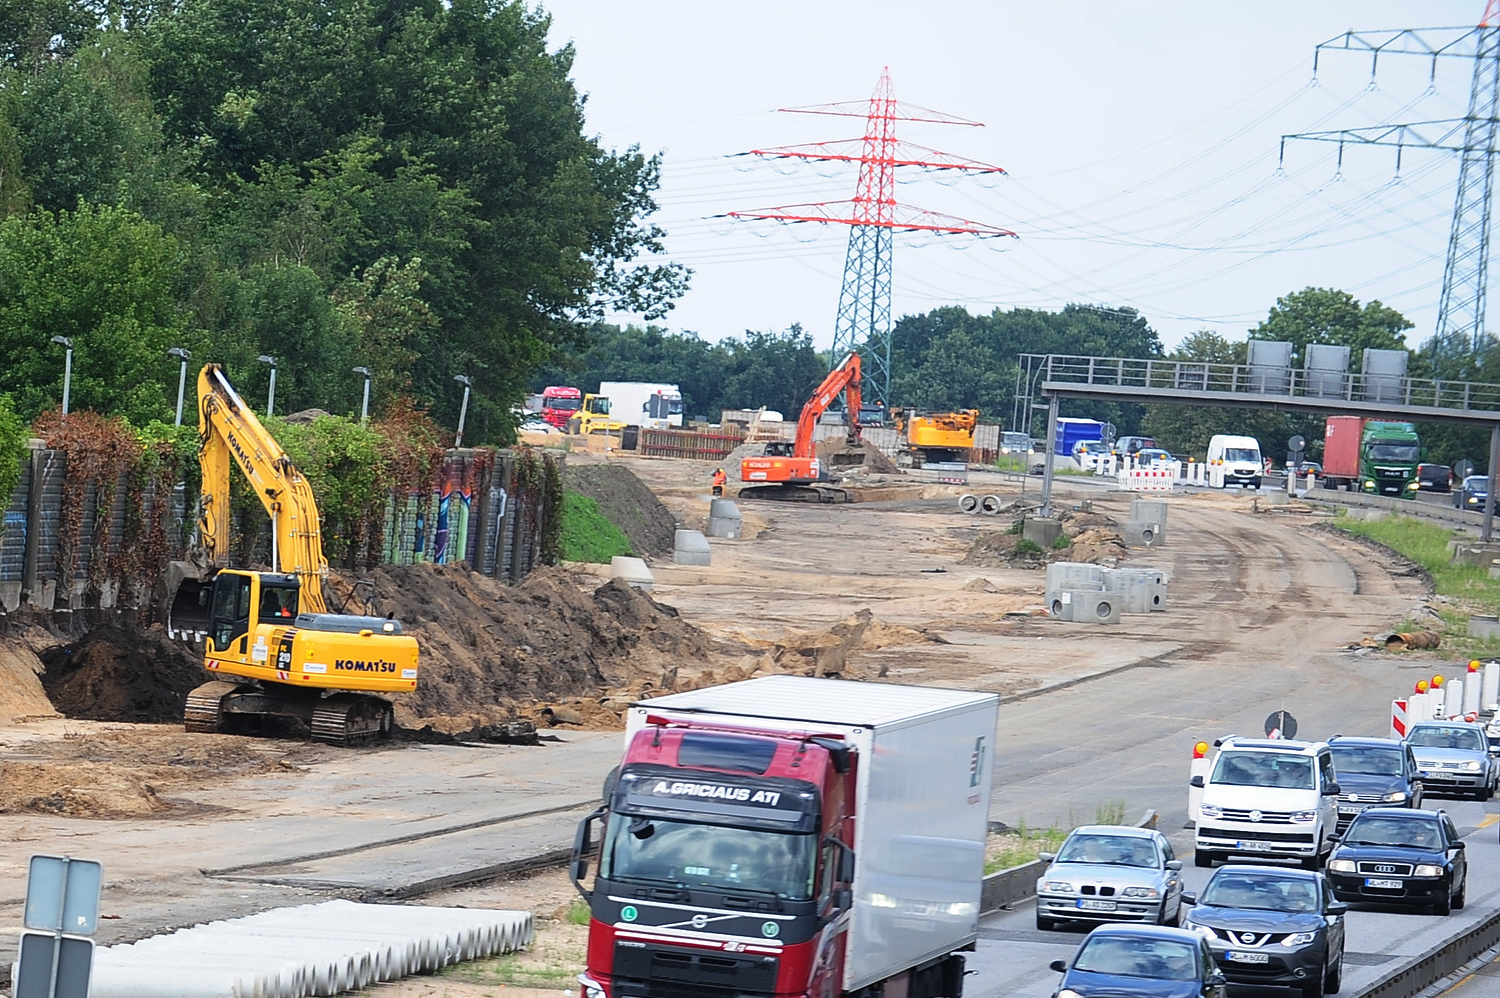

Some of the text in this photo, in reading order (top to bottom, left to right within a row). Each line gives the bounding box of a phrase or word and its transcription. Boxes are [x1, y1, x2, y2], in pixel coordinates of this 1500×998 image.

[227, 431, 254, 475] KOMATSU
[335, 659, 396, 673] KOMATSU
[626, 908, 632, 919] L
